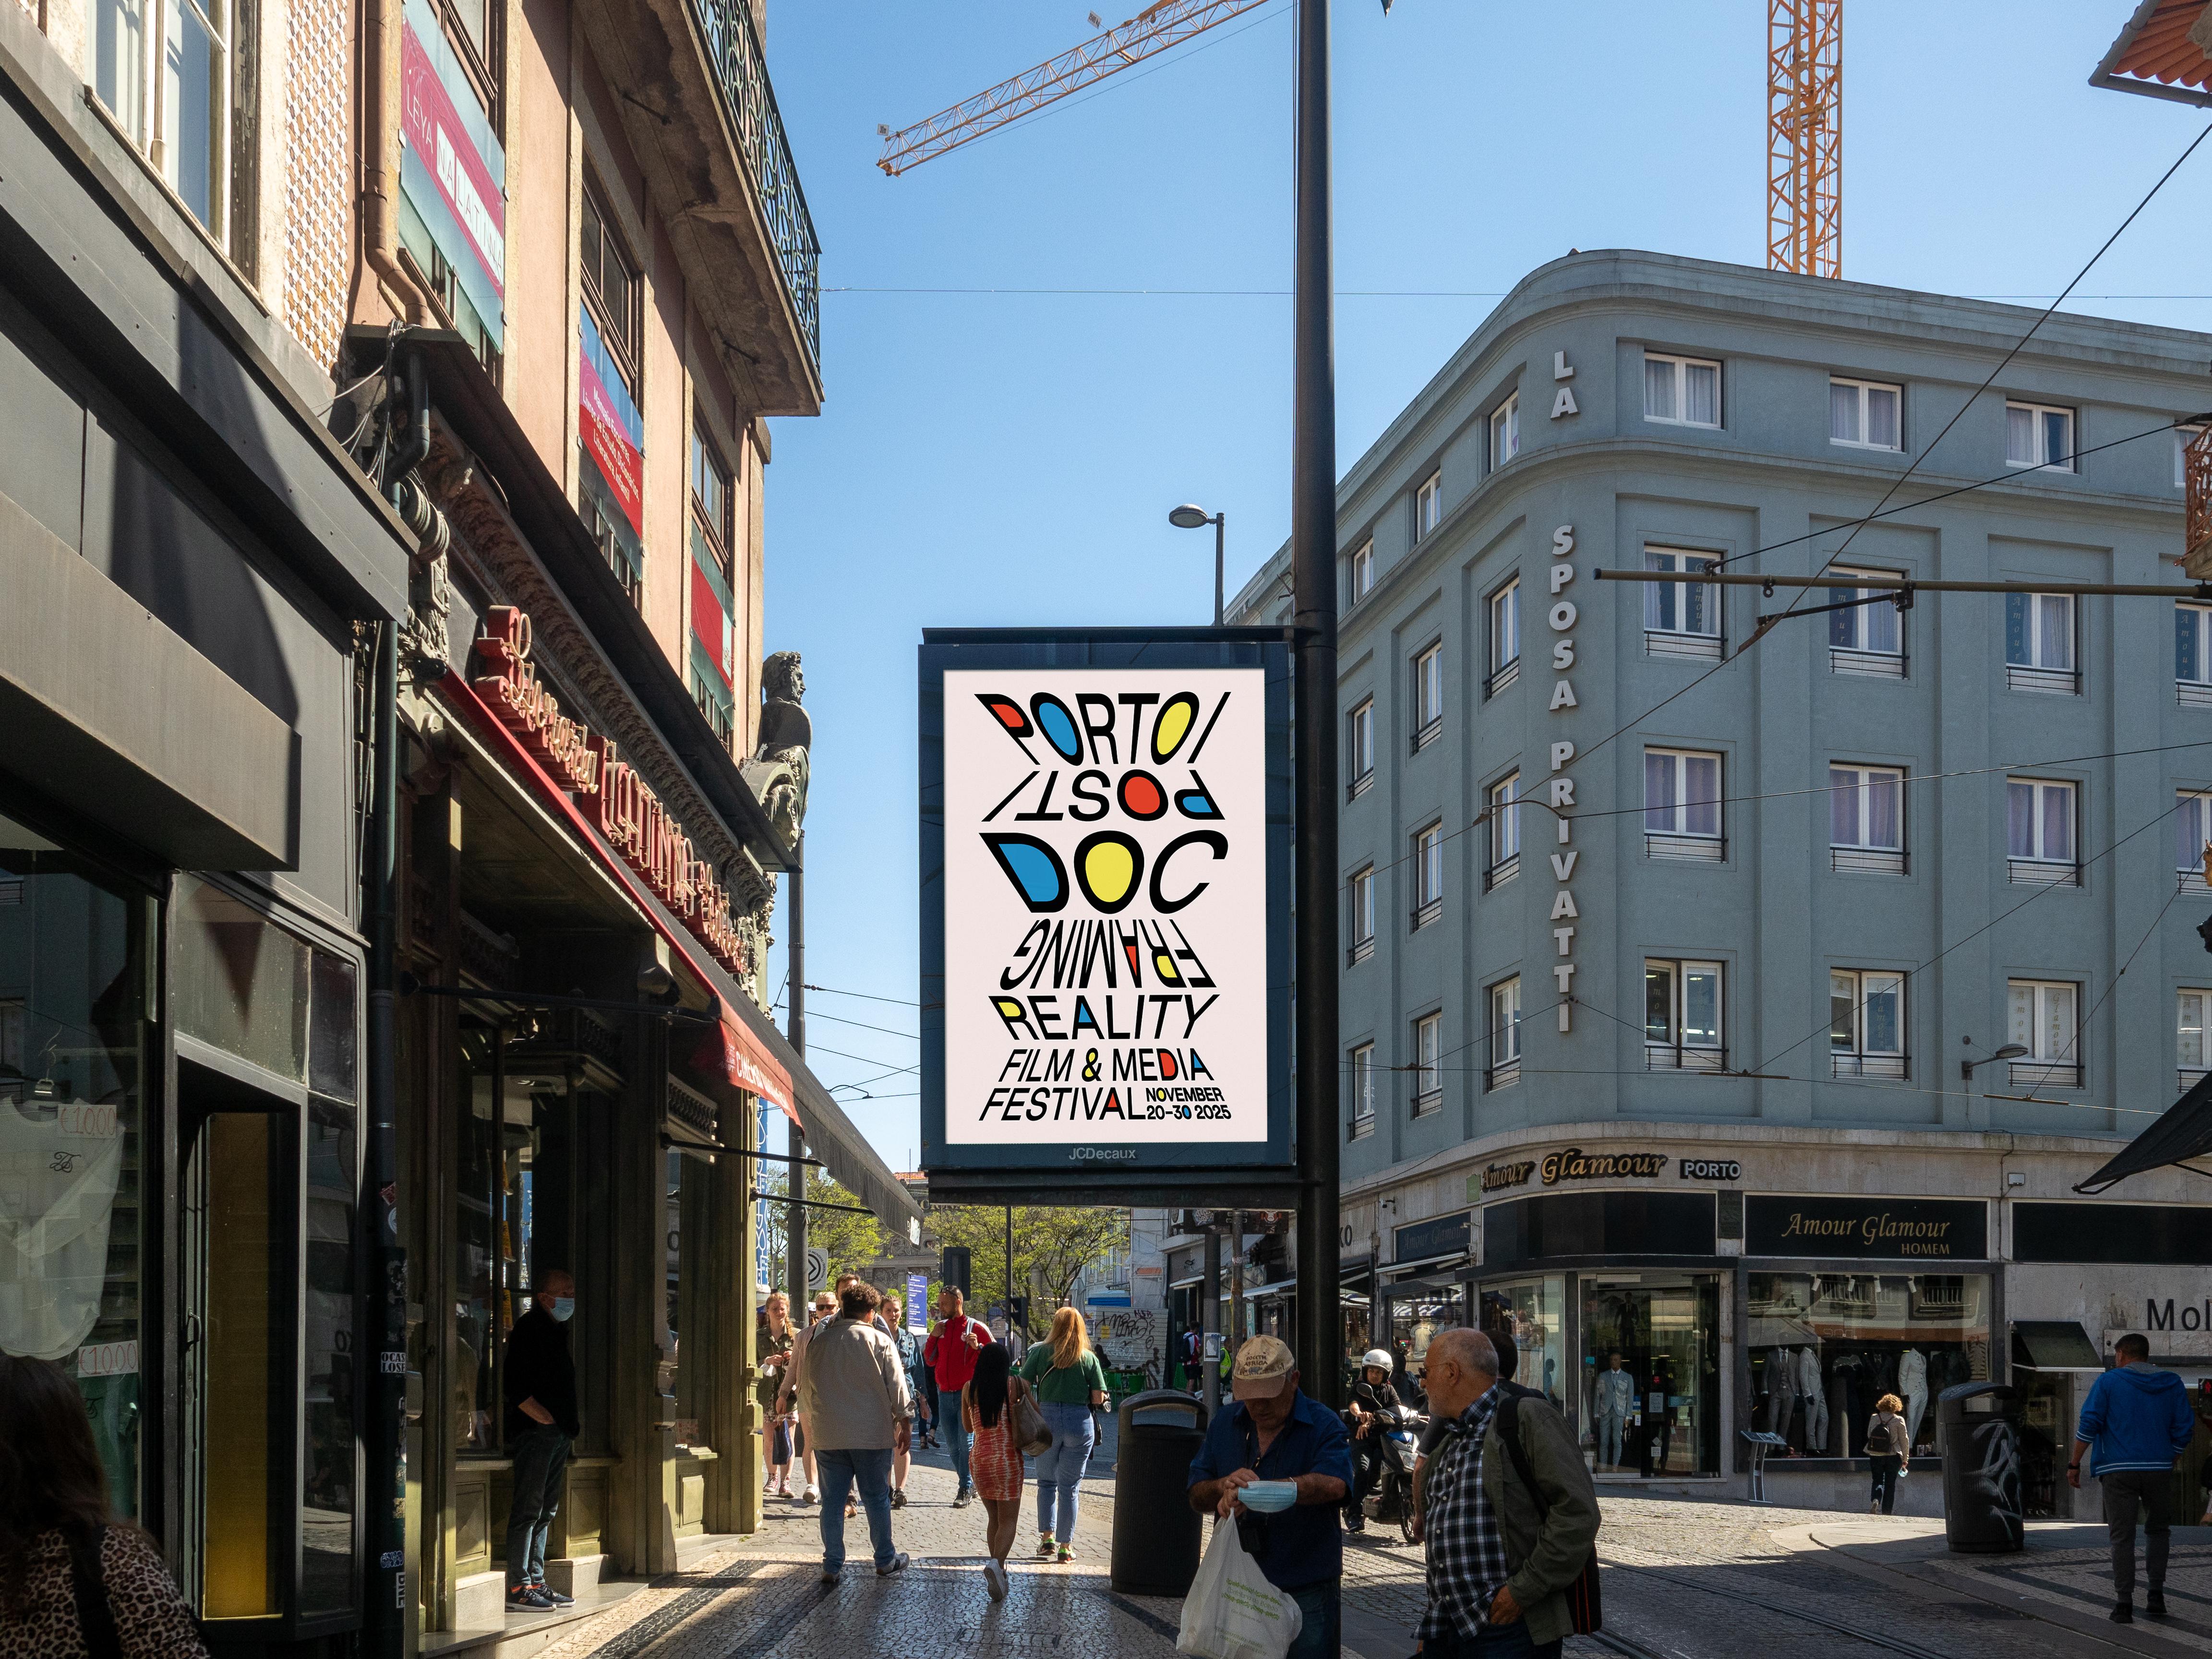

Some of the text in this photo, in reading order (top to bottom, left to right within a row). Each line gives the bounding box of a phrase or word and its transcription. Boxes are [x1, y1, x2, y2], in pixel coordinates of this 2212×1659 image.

[407, 83, 502, 280] LEYA NA LATINA
[1551, 350, 1580, 421] LA
[1549, 525, 1579, 711] SPOSA
[979, 830, 1228, 914] DOC
[1550, 741, 1579, 1033] PRIVATTI
[1000, 919, 1216, 990] FRAMING
[988, 995, 1220, 1040] REALITY
[998, 1048, 1214, 1082] FILM & MEDIA
[979, 1087, 1145, 1121] FESTIVAL
[1146, 1088, 1225, 1102] NOVEMBER
[1195, 1105, 1231, 1119] 2025
[1069, 1147, 1136, 1160] JCDecaux
[1482, 1150, 1741, 1191] Amour Glamour PORTO
[1781, 1213, 1950, 1245] Amour Glamour
[1901, 1243, 1950, 1255] HOMEM
